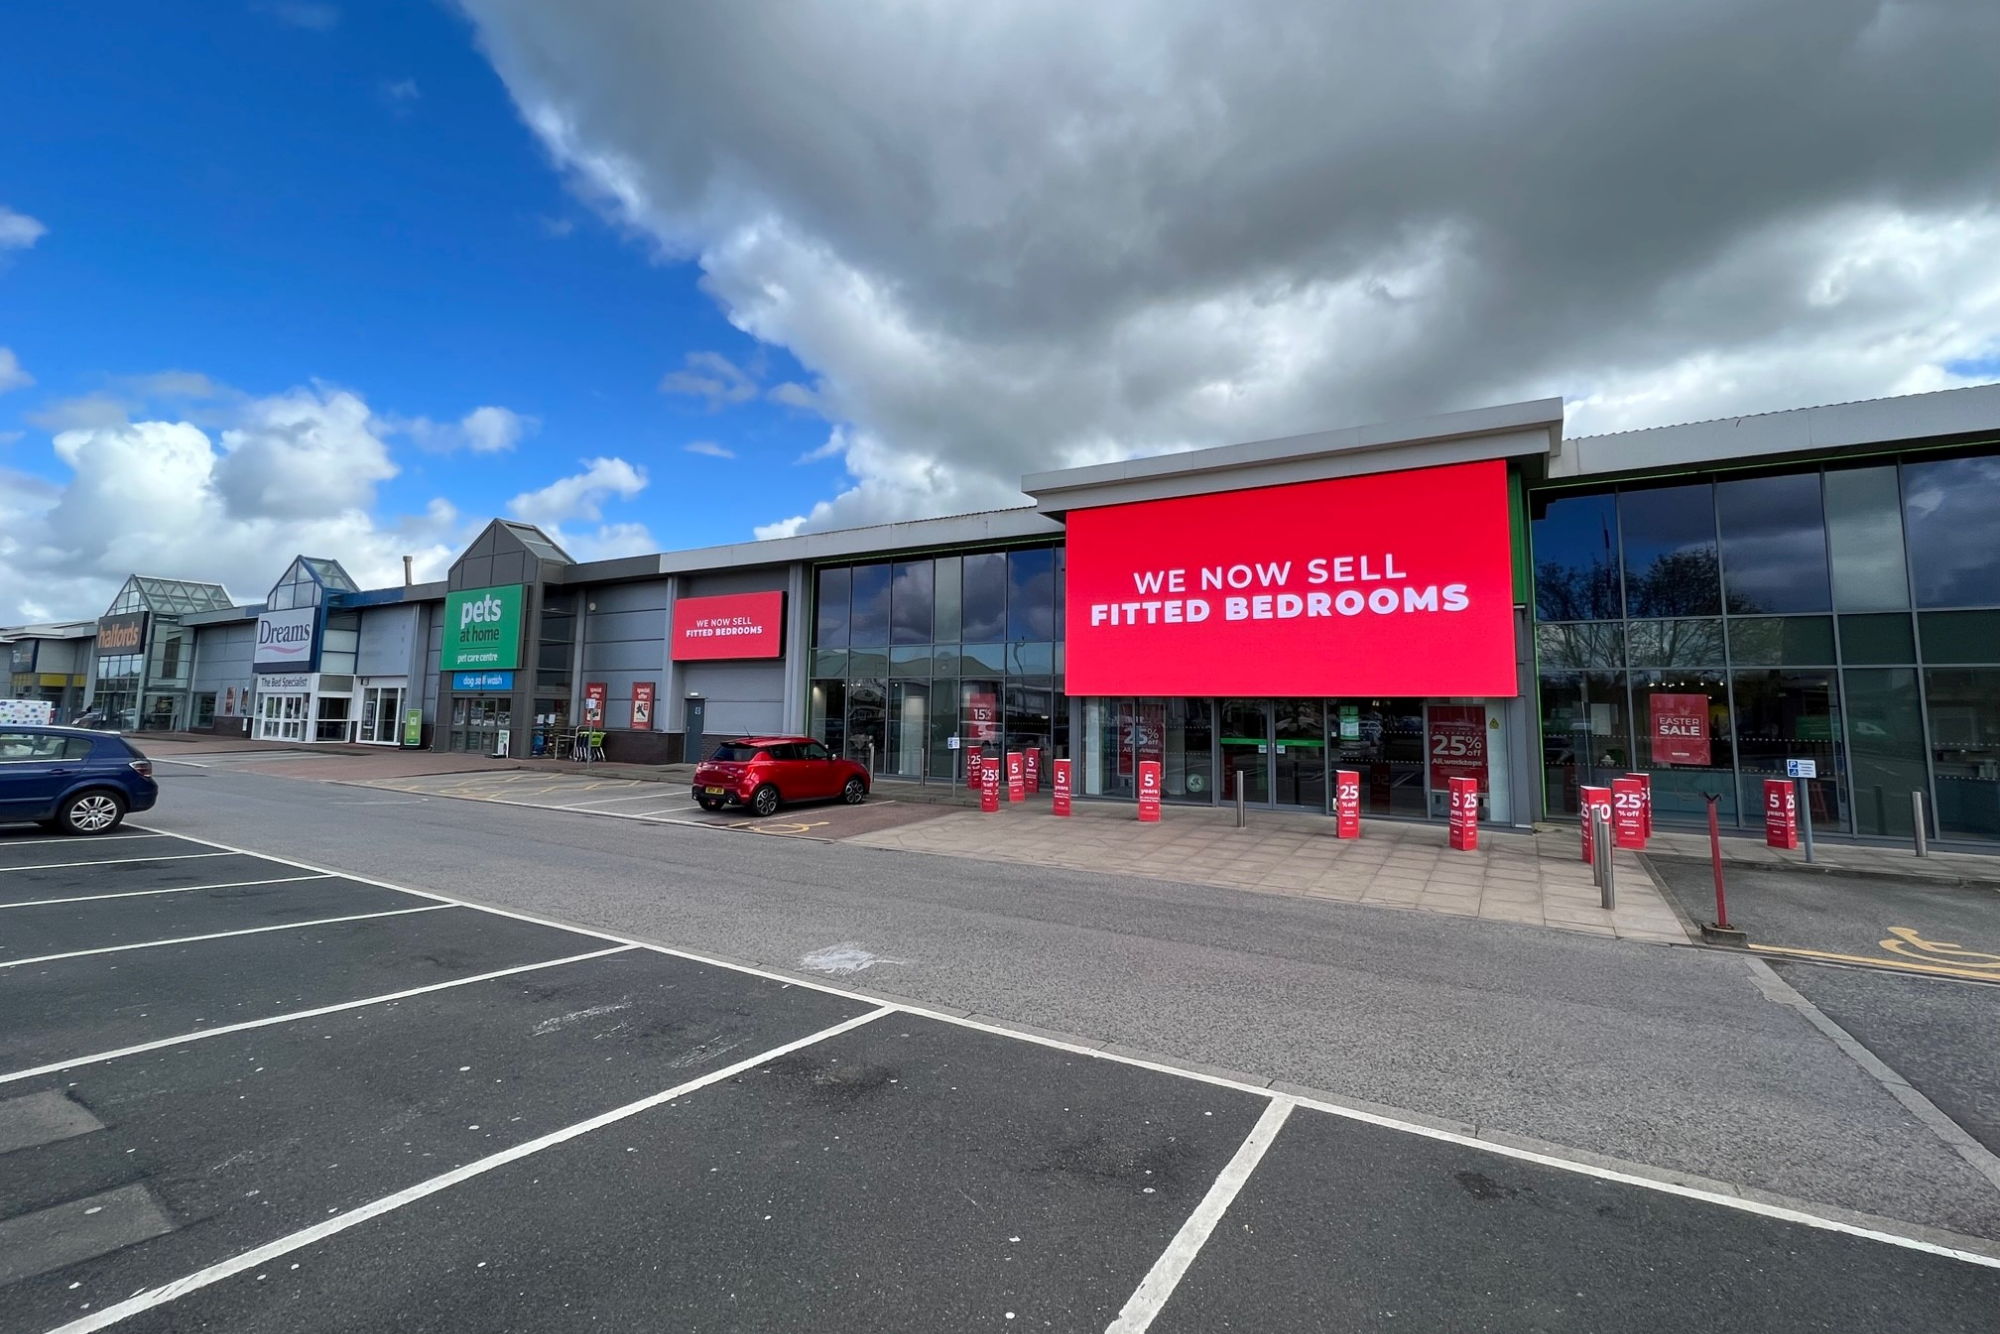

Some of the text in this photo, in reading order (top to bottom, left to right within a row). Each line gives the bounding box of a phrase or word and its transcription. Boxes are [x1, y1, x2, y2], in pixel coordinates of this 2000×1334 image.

[1133, 554, 1406, 594] WE NOW SELL
[461, 594, 502, 629] pets
[1090, 584, 1469, 626] FITTED BEDROOMS
[711, 618, 730, 626] NOW
[732, 617, 752, 626] SELL
[98, 622, 138, 648] halfords
[258, 620, 310, 644] Dreams
[460, 625, 500, 642] at home
[686, 626, 762, 637] FITTED BEDROOMS
[457, 654, 466, 664] pet
[480, 653, 498, 662] centre
[262, 677, 308, 690] The Bed Specialist
[463, 676, 474, 688] dog
[487, 674, 502, 684] wash
[1124, 728, 1159, 744] 25%
[1660, 726, 1700, 736] SALE
[1432, 734, 1482, 756] 25%
[971, 755, 981, 764] 25
[1028, 758, 1034, 767] 5
[982, 769, 995, 780] 25
[1011, 763, 1019, 773] 5
[1057, 772, 1065, 783] 5
[1144, 774, 1154, 787] 5
[1340, 785, 1358, 799] 25
[1452, 792, 1460, 807] 5
[1464, 793, 1477, 808] 25
[1615, 794, 1641, 808] 25
[1770, 794, 1780, 808] 5
